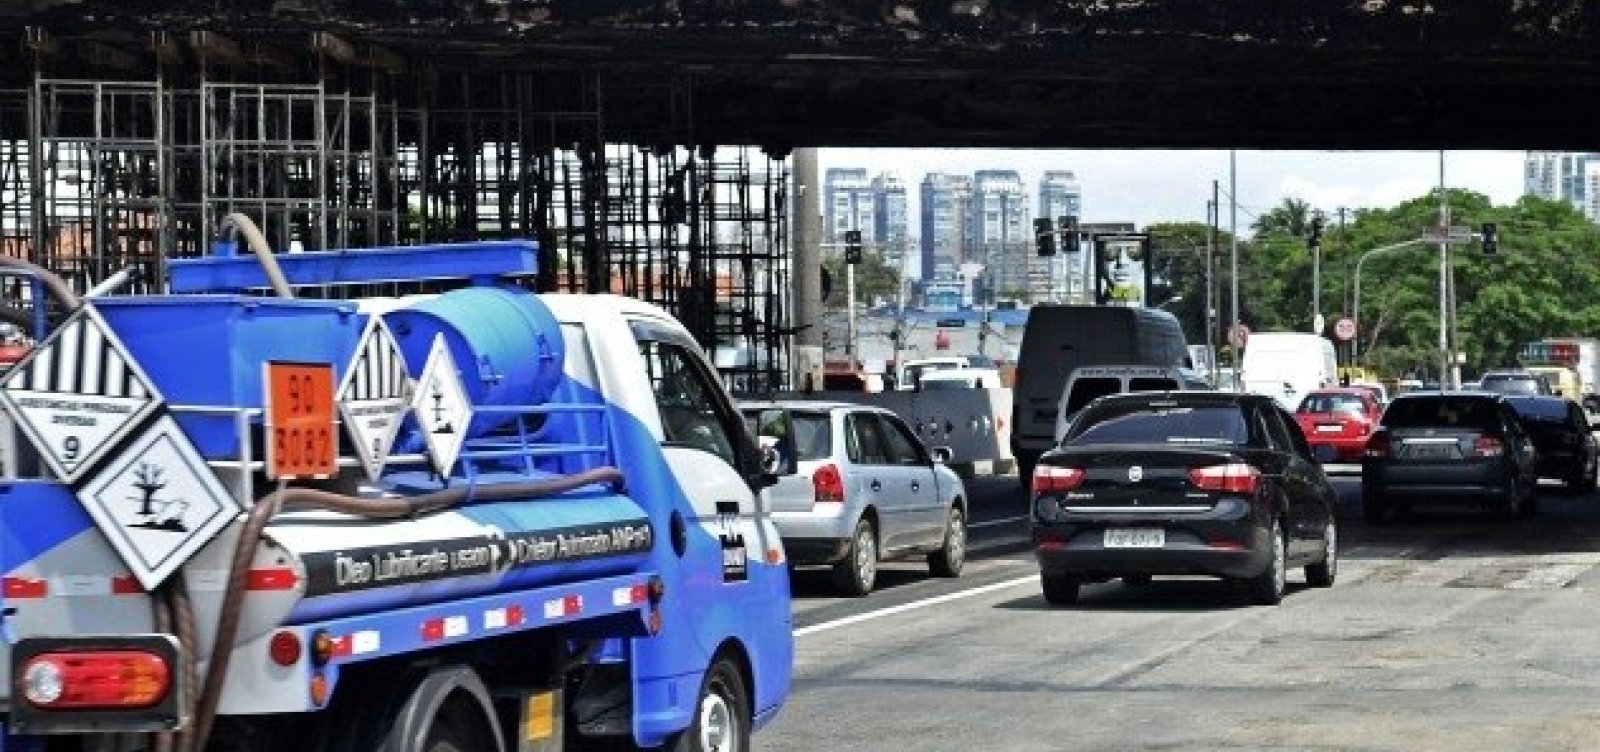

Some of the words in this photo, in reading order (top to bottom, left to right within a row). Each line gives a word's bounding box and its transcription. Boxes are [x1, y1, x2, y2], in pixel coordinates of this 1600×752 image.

[288, 375, 314, 413] 90
[62, 436, 82, 459] 9
[275, 428, 329, 467] 3082
